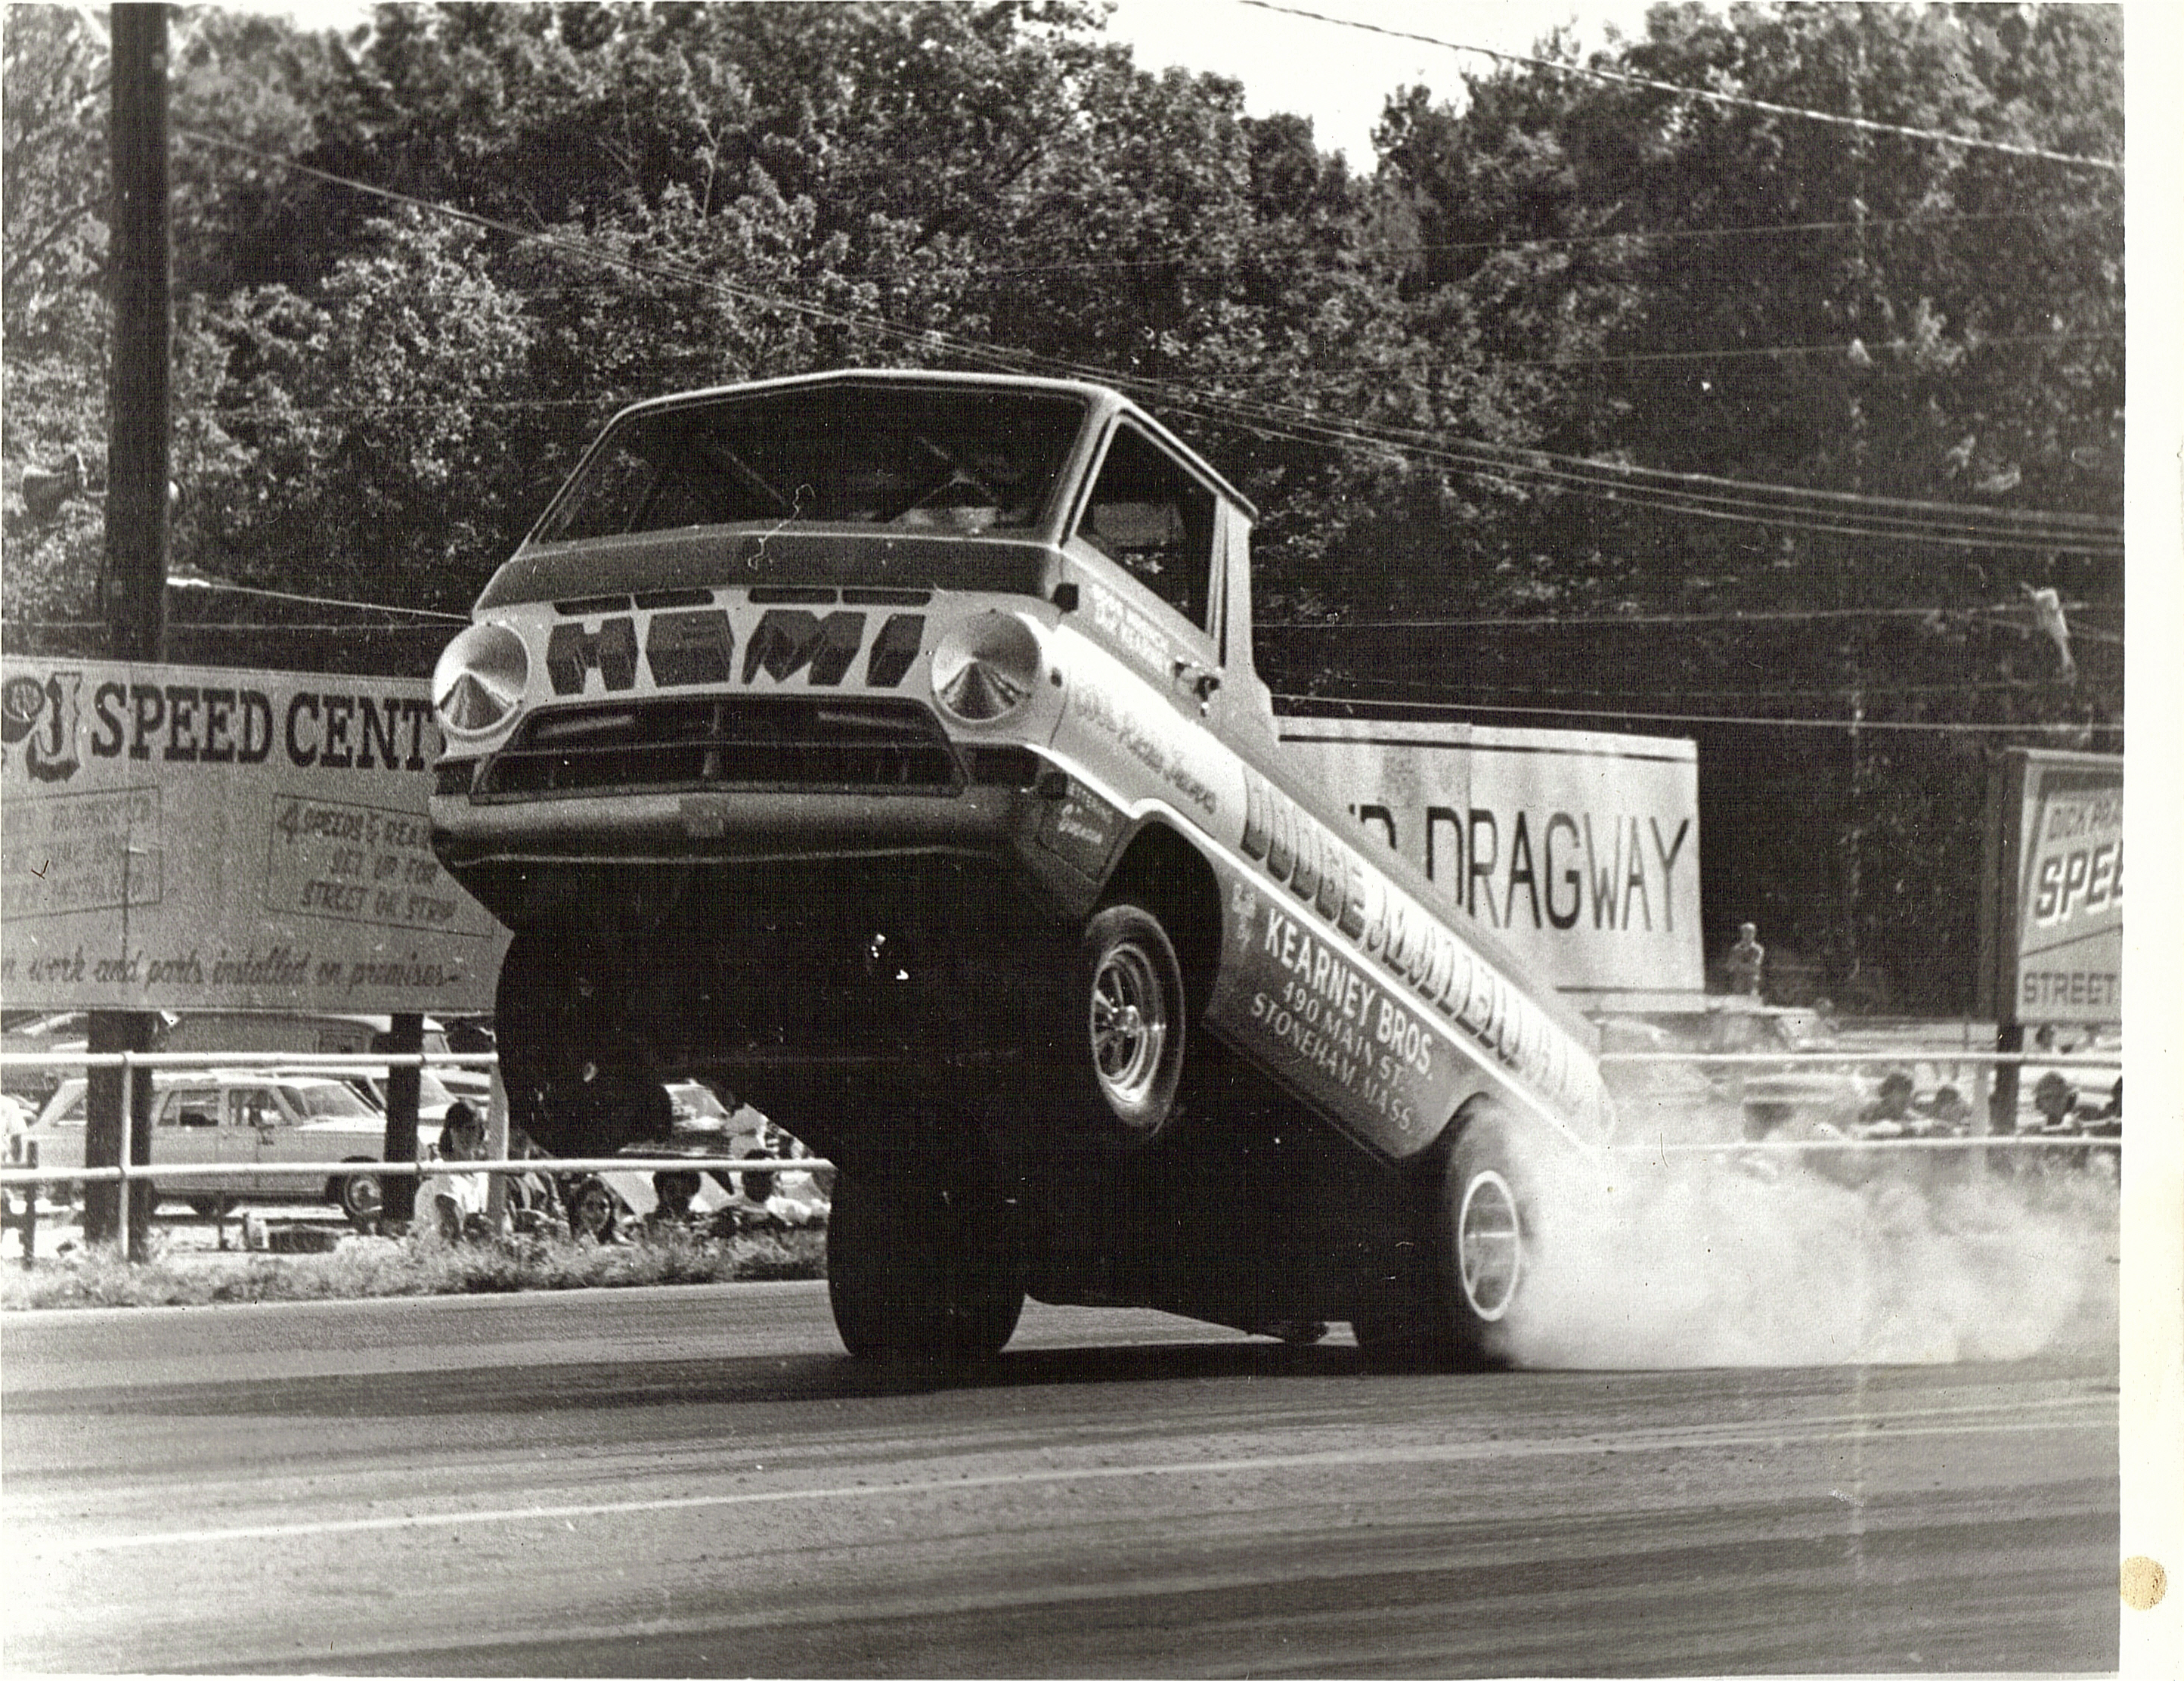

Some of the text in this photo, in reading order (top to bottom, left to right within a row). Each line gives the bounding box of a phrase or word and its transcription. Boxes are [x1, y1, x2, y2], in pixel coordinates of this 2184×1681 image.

[546, 609, 926, 696] HEMI
[91, 681, 274, 764] SPEED
[284, 691, 438, 772] CENT
[1427, 806, 1690, 931] DRAGWAY
[94, 949, 143, 982] and
[1265, 907, 1376, 1027] KEARNEY
[2022, 971, 2117, 1005] STREET
[1324, 1010, 1372, 1066] MAIN
